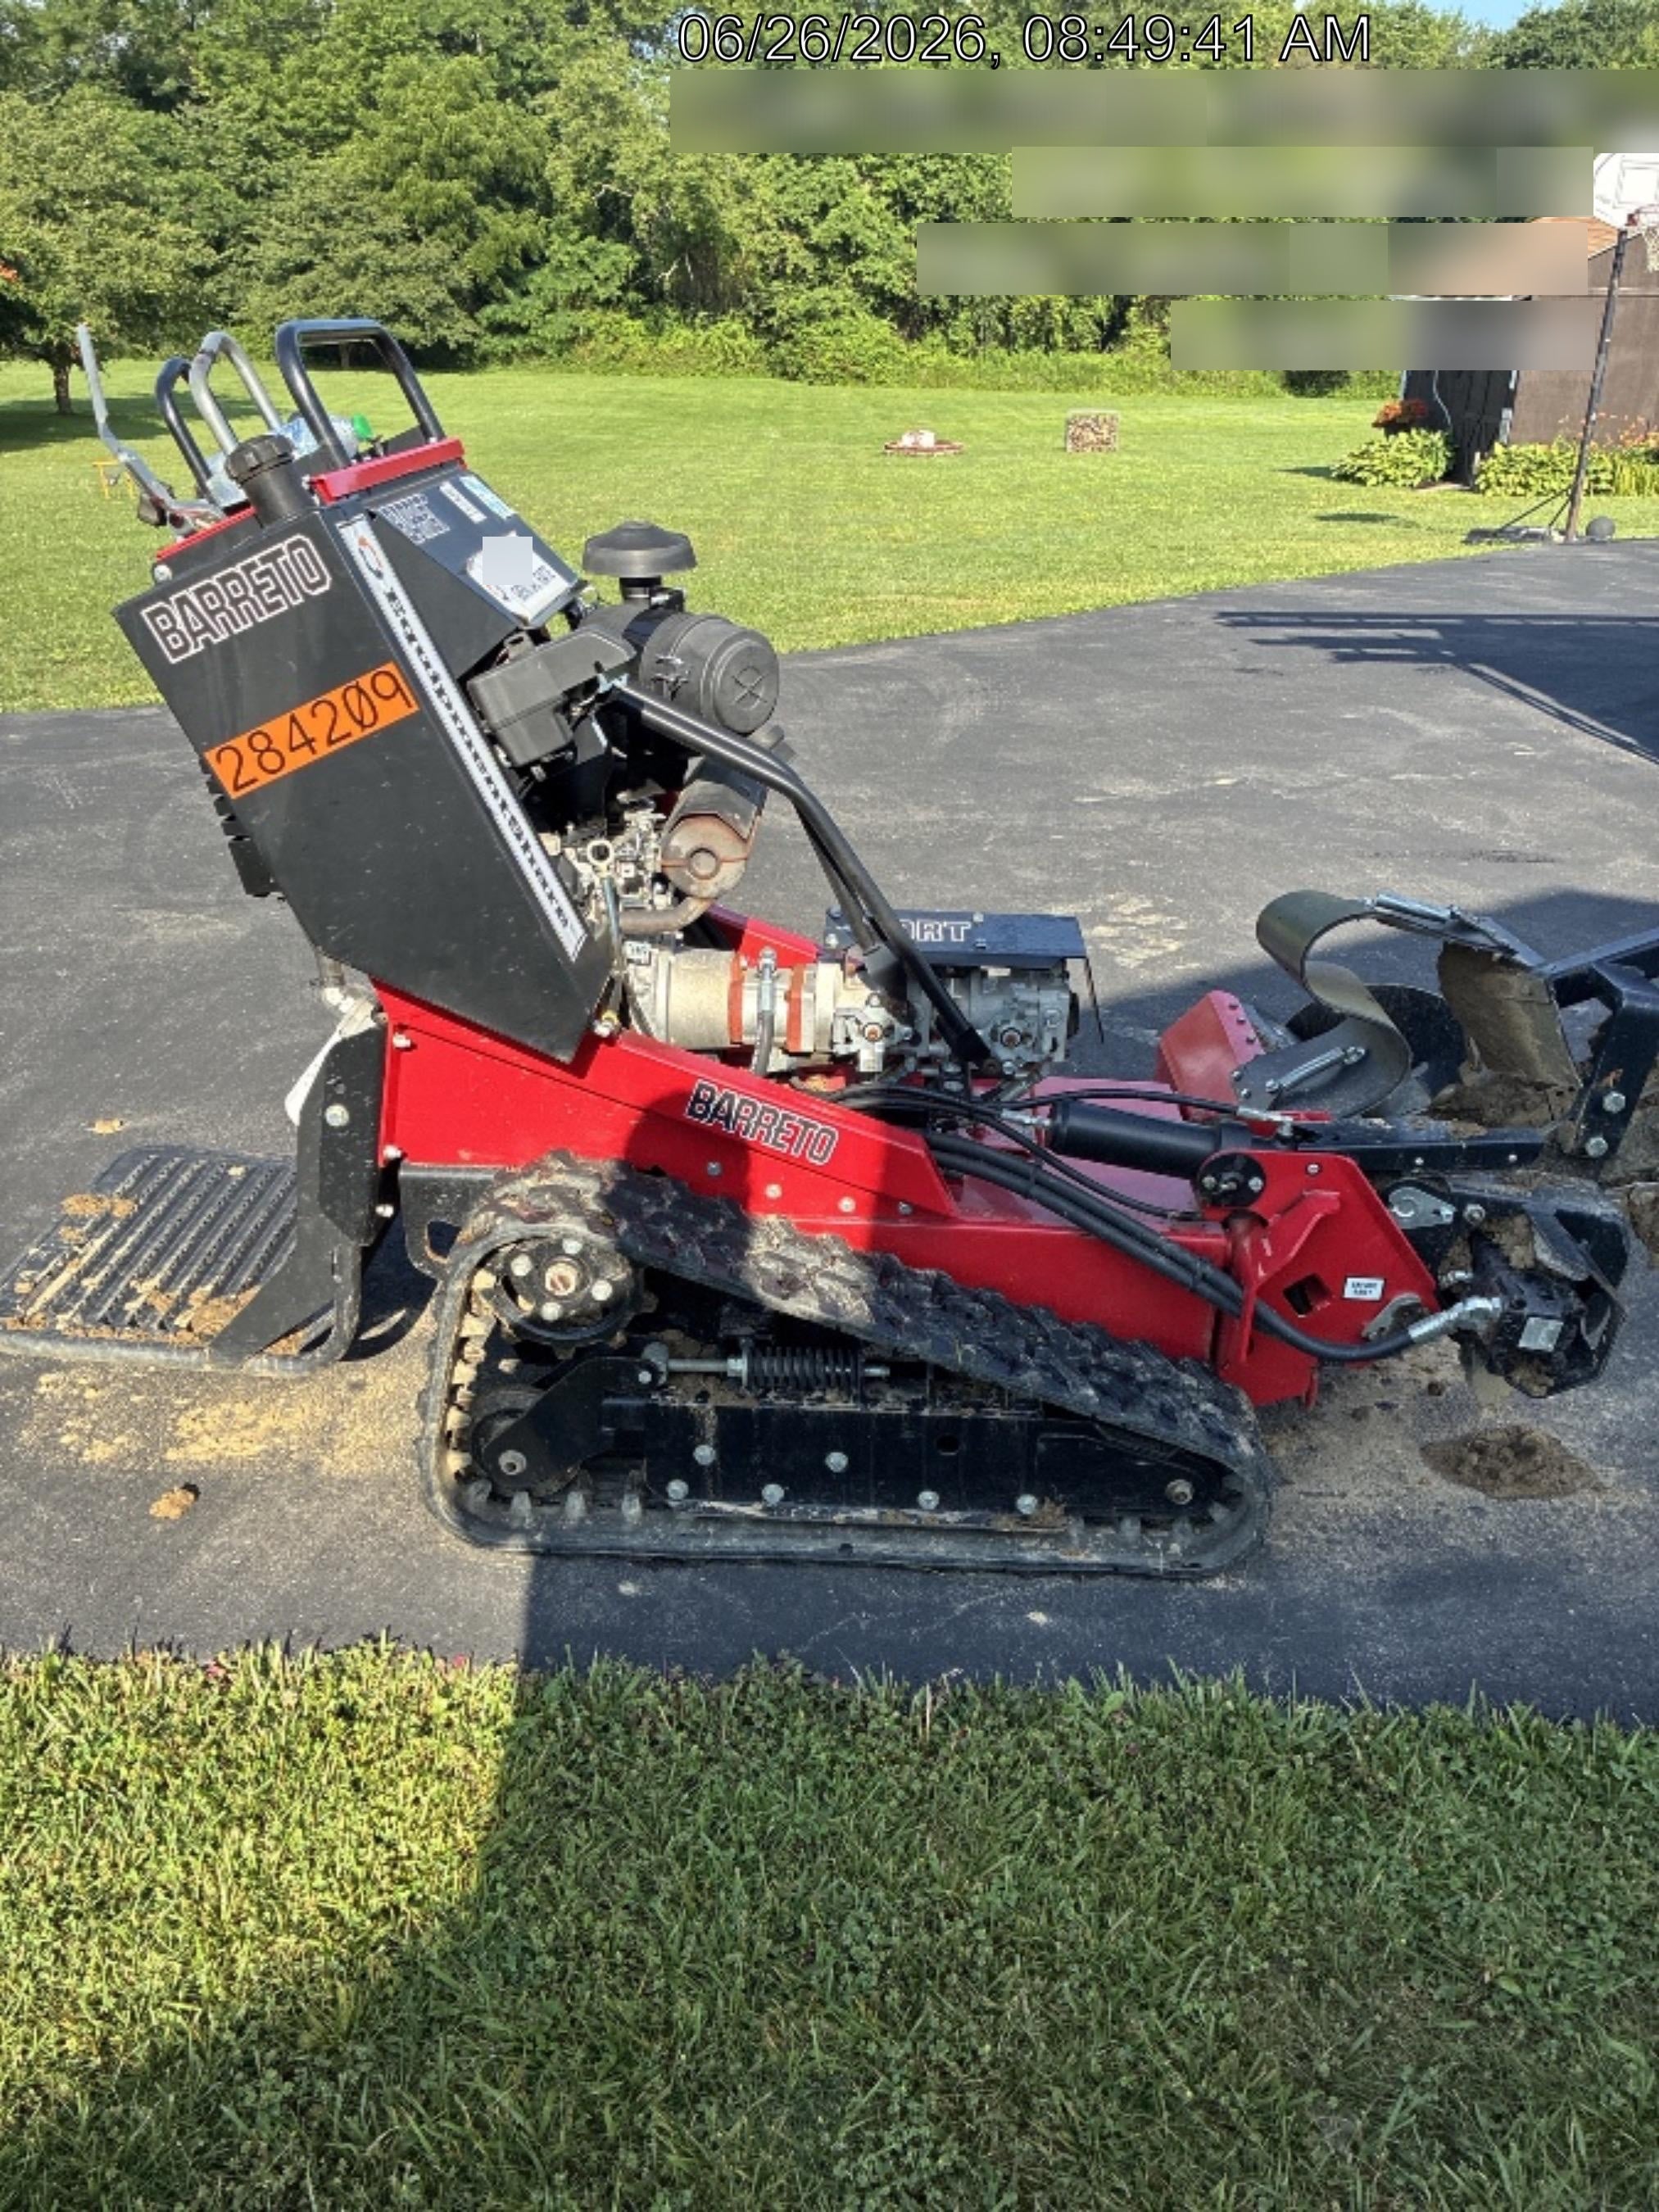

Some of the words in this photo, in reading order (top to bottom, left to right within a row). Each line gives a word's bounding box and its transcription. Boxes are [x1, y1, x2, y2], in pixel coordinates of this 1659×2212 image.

[139, 533, 332, 664] BARRETO
[215, 669, 414, 792] 284209
[685, 1079, 839, 1165] BARRETO
